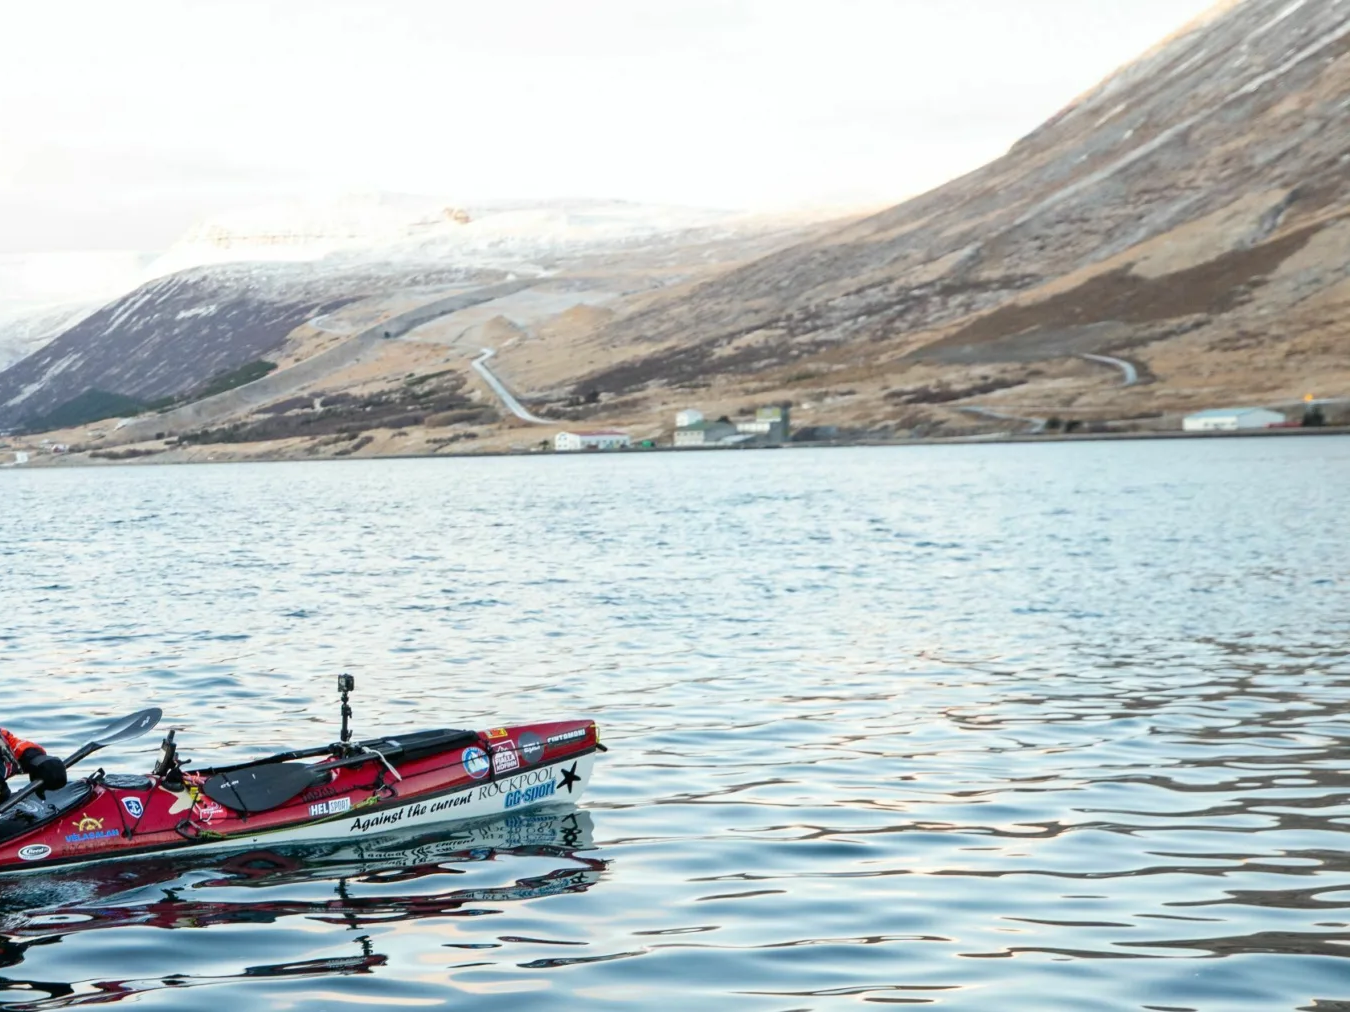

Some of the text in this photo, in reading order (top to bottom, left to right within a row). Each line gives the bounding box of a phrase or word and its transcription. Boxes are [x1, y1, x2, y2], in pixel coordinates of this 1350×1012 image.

[478, 767, 556, 800] ROCKPOOL
[350, 790, 473, 832] Against the current
